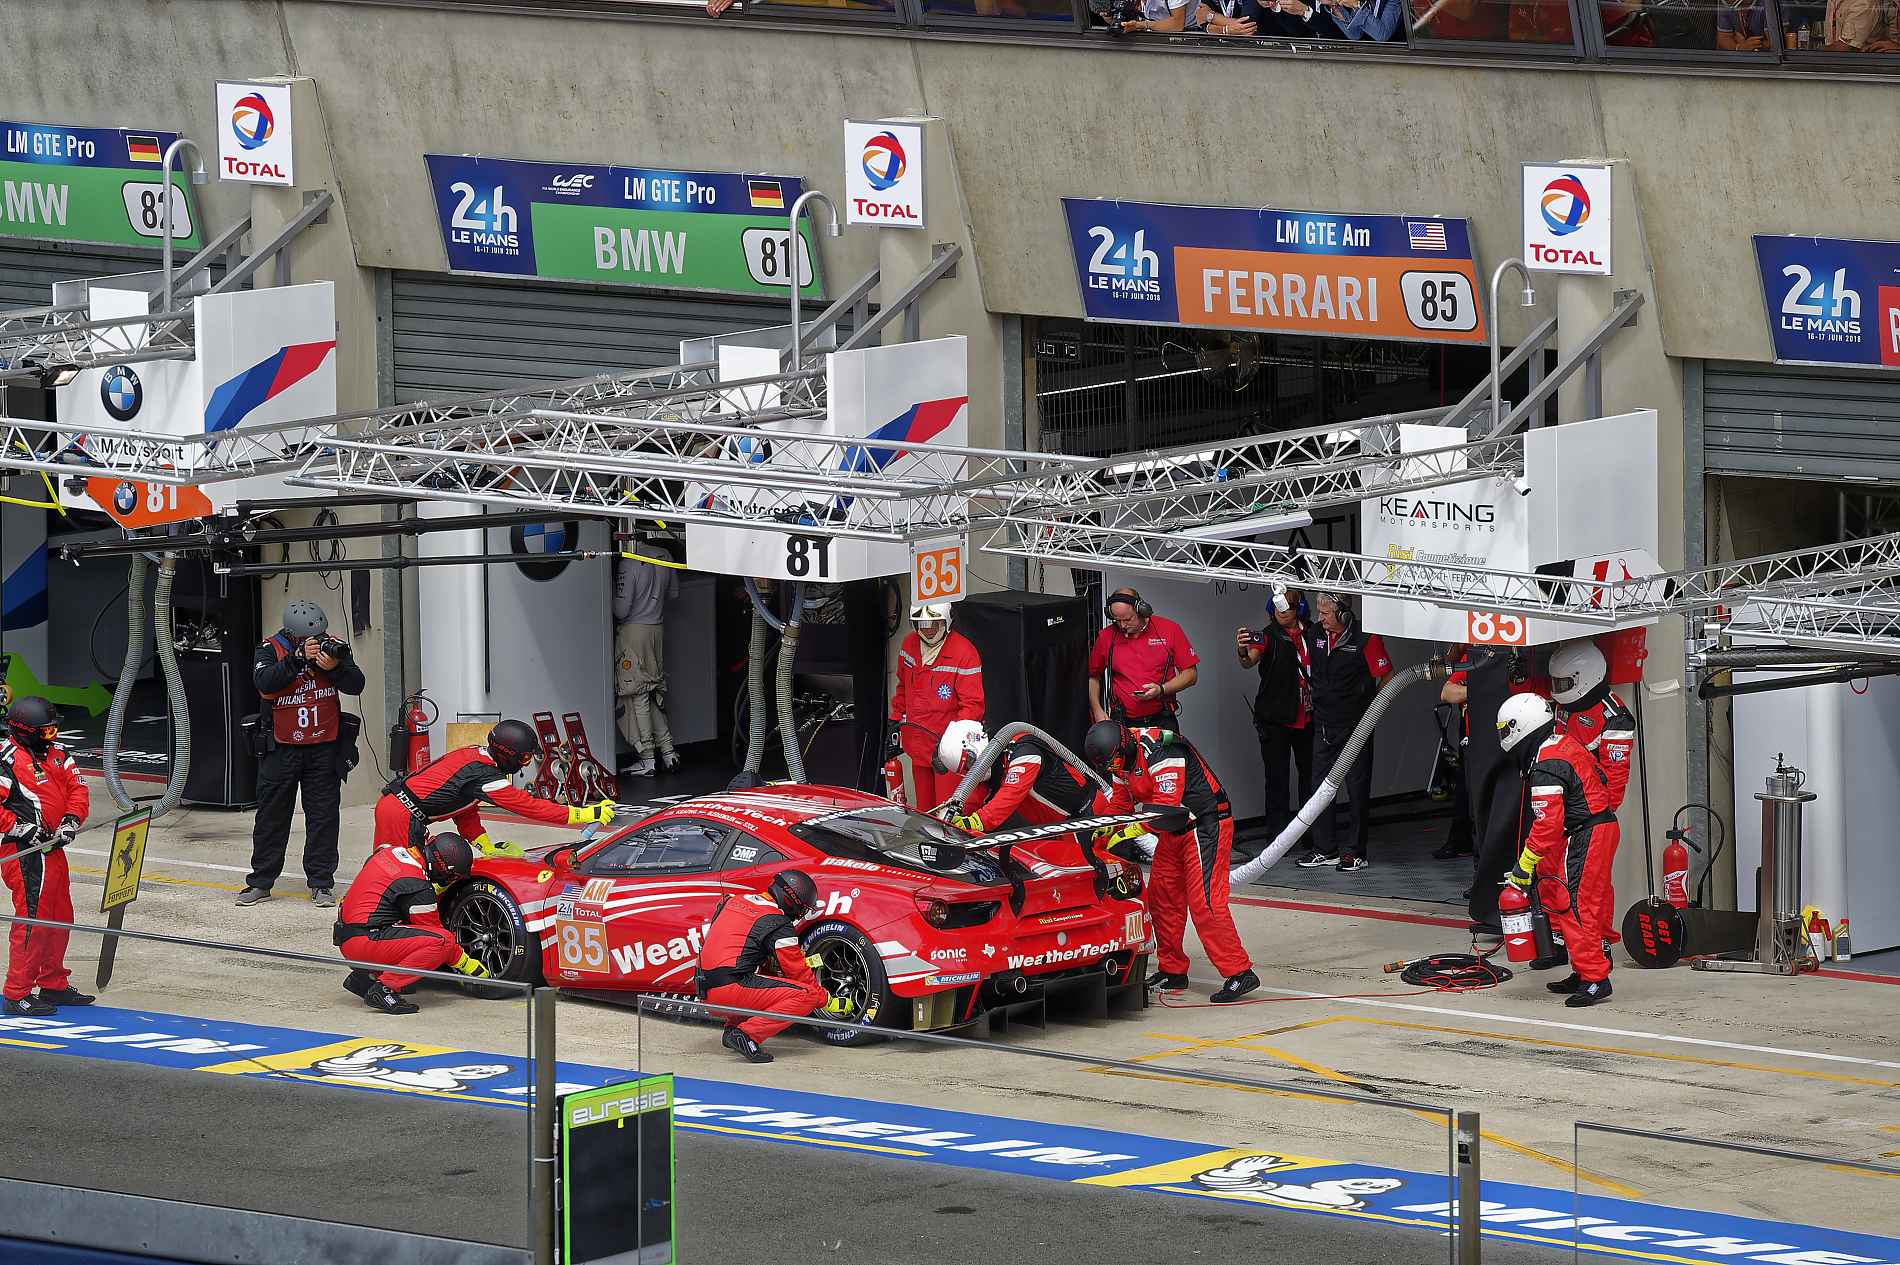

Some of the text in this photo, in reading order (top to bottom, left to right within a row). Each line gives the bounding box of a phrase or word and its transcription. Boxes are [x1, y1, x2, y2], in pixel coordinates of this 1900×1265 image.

[7, 129, 96, 159] LM GTE Pro
[223, 156, 286, 178] TOTAL
[0, 180, 69, 226] MW
[624, 176, 716, 205] LM GTE Pro
[450, 182, 518, 233] 24h
[853, 198, 918, 219] TOTAL
[451, 230, 519, 248] LE MANS
[1275, 219, 1371, 247] LM GTE Am
[593, 226, 687, 274] BMW
[1087, 225, 1159, 278] 24h
[1529, 243, 1602, 266] TOTAL
[1088, 275, 1161, 293] LE MANS
[1202, 267, 1378, 322] FERRARI
[1781, 264, 1861, 319] 24h
[1420, 279, 1458, 322] 85
[1781, 316, 1861, 334] LE MANS
[1807, 332, 1825, 341] 16-17
[1380, 496, 1495, 523] KEATING
[1380, 516, 1495, 532] MOTORSPORTS
[786, 536, 830, 578] 81
[919, 551, 958, 597] 85
[297, 705, 319, 728] 81
[733, 847, 757, 859] OMP
[575, 908, 602, 918] TOTAL
[562, 925, 604, 967] 85
[1638, 912, 1658, 956] READY
[1656, 919, 1672, 945] GET
[1007, 939, 1120, 970] WeatherTech
[940, 973, 979, 983] MICHELIN
[827, 1028, 863, 1041] ICHELIN
[572, 1090, 668, 1125] eurasia
